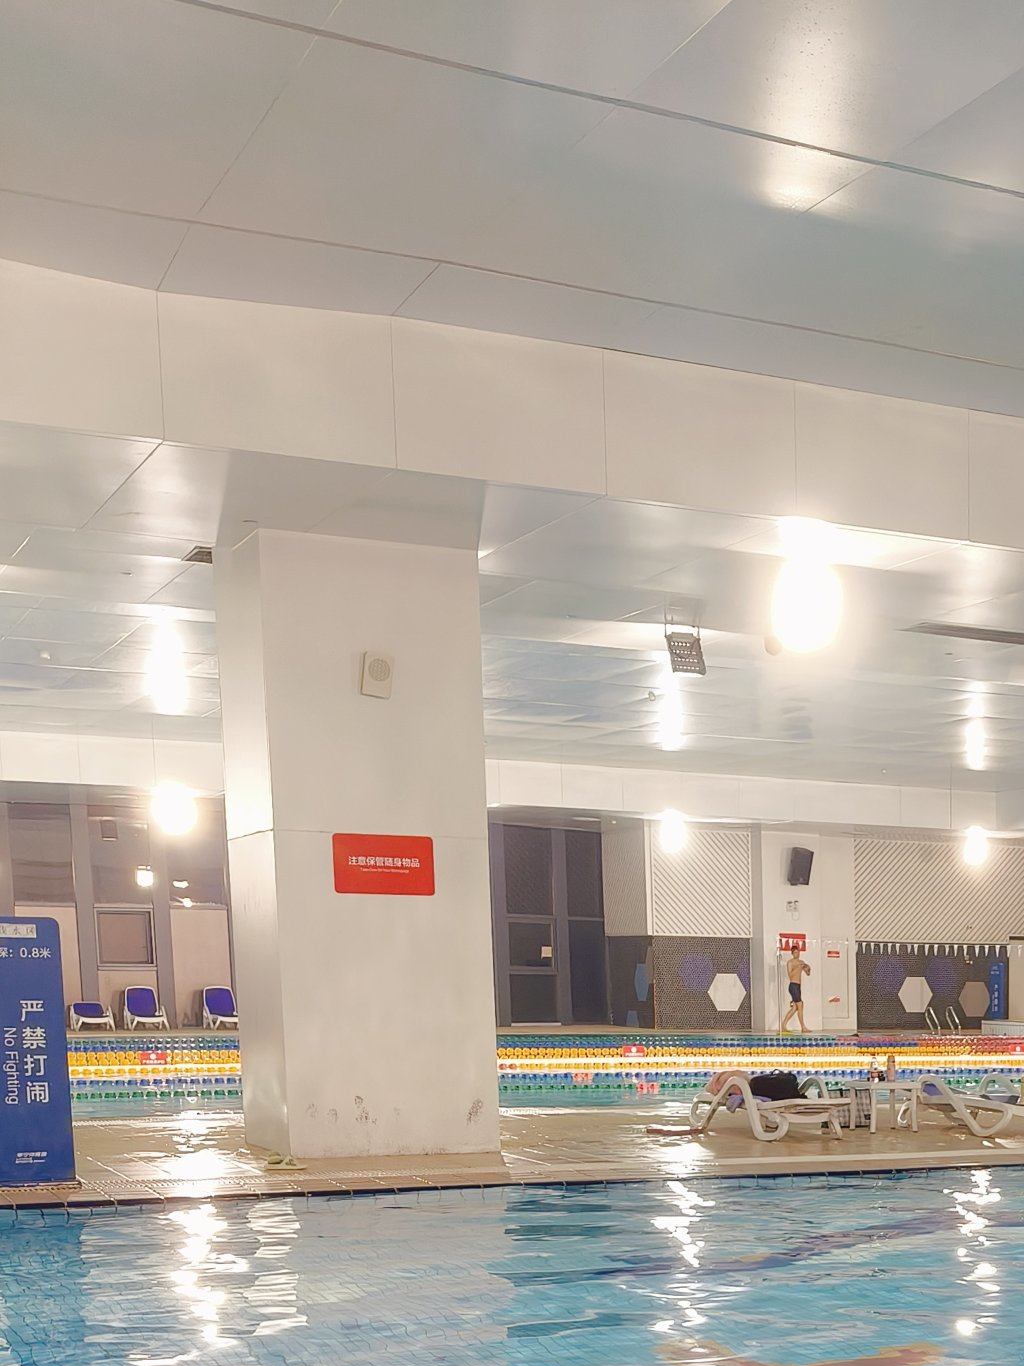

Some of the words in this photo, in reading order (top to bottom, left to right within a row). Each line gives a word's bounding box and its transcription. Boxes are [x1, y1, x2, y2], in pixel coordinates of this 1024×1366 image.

[348, 856, 420, 868] 注意保管随身物品
[3, 1027, 18, 1047] No
[19, 1000, 50, 1104] 严禁打闹
[2, 1051, 21, 1105] Fighting
